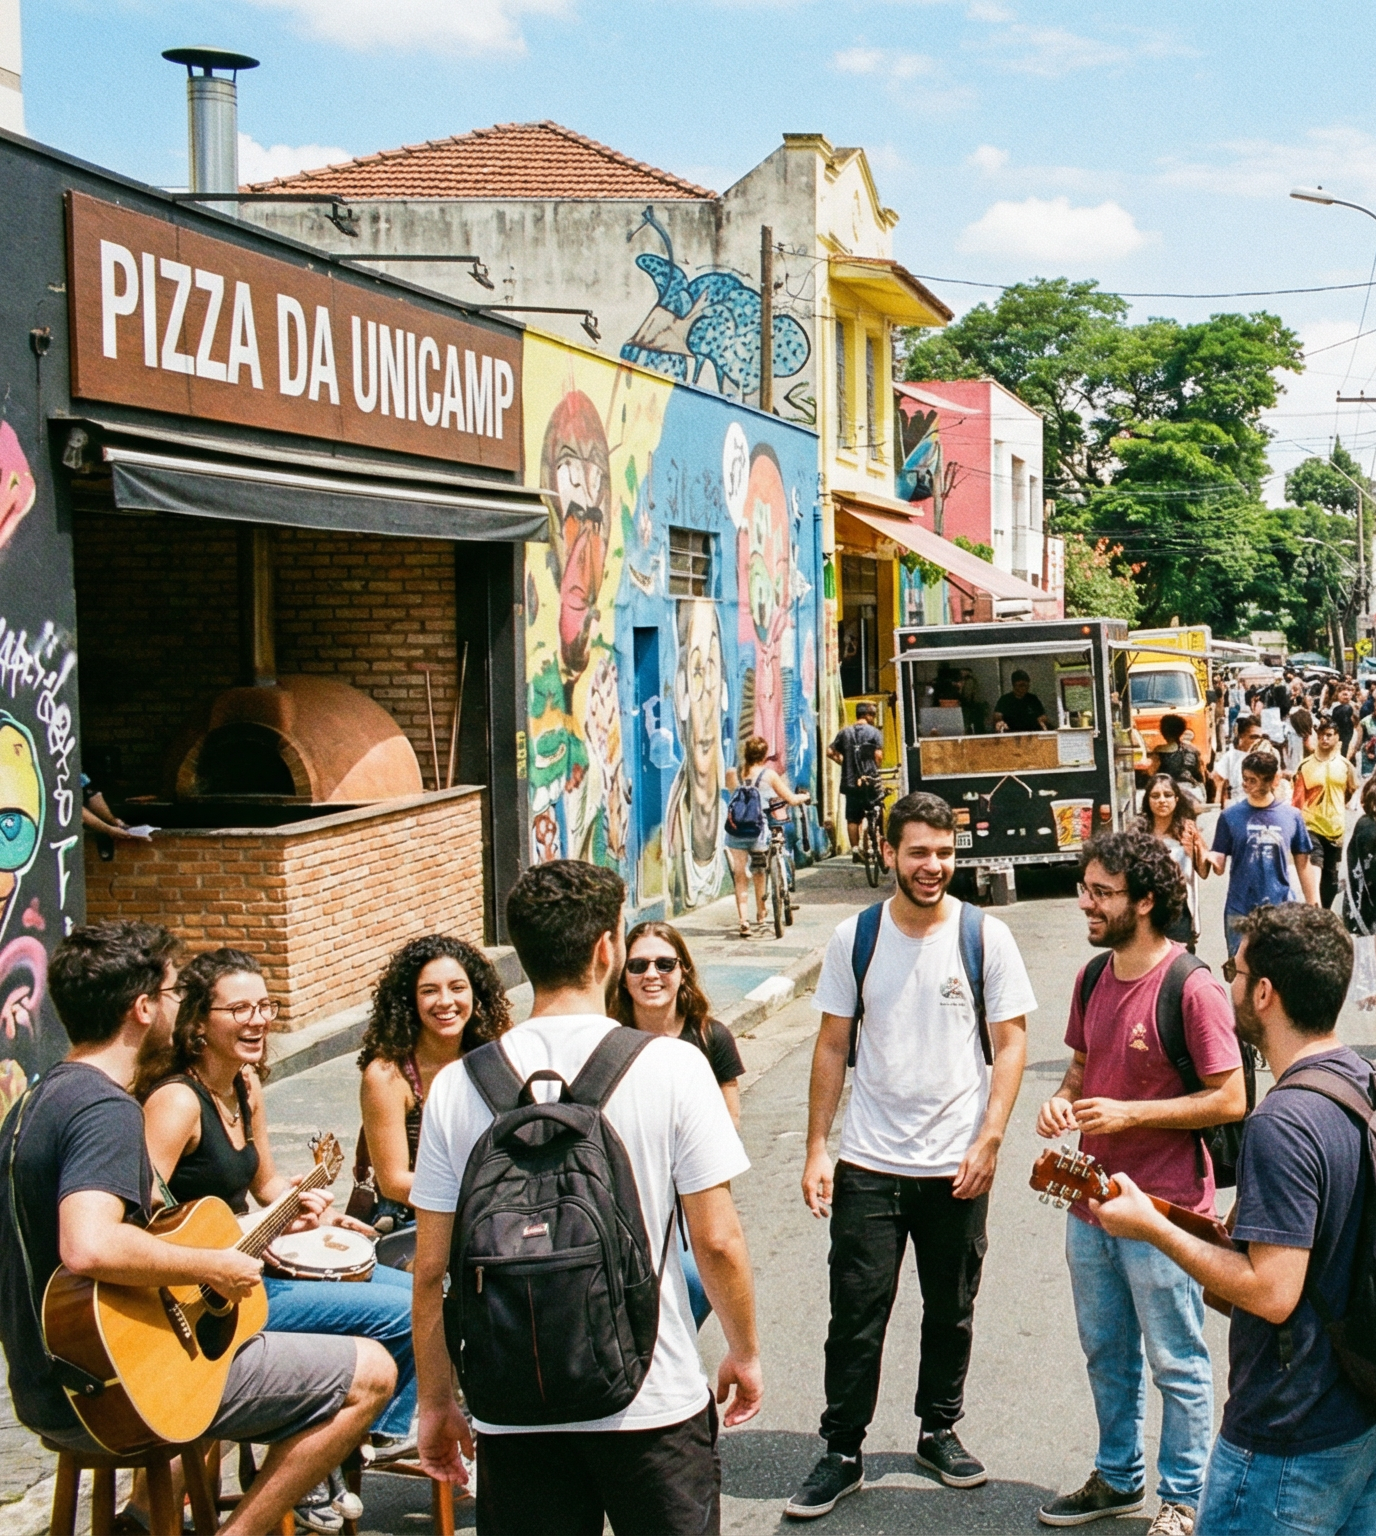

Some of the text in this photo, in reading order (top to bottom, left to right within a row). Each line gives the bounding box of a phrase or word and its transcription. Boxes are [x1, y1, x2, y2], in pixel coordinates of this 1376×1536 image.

[100, 238, 515, 441] PIZZA DA UNICAMP
